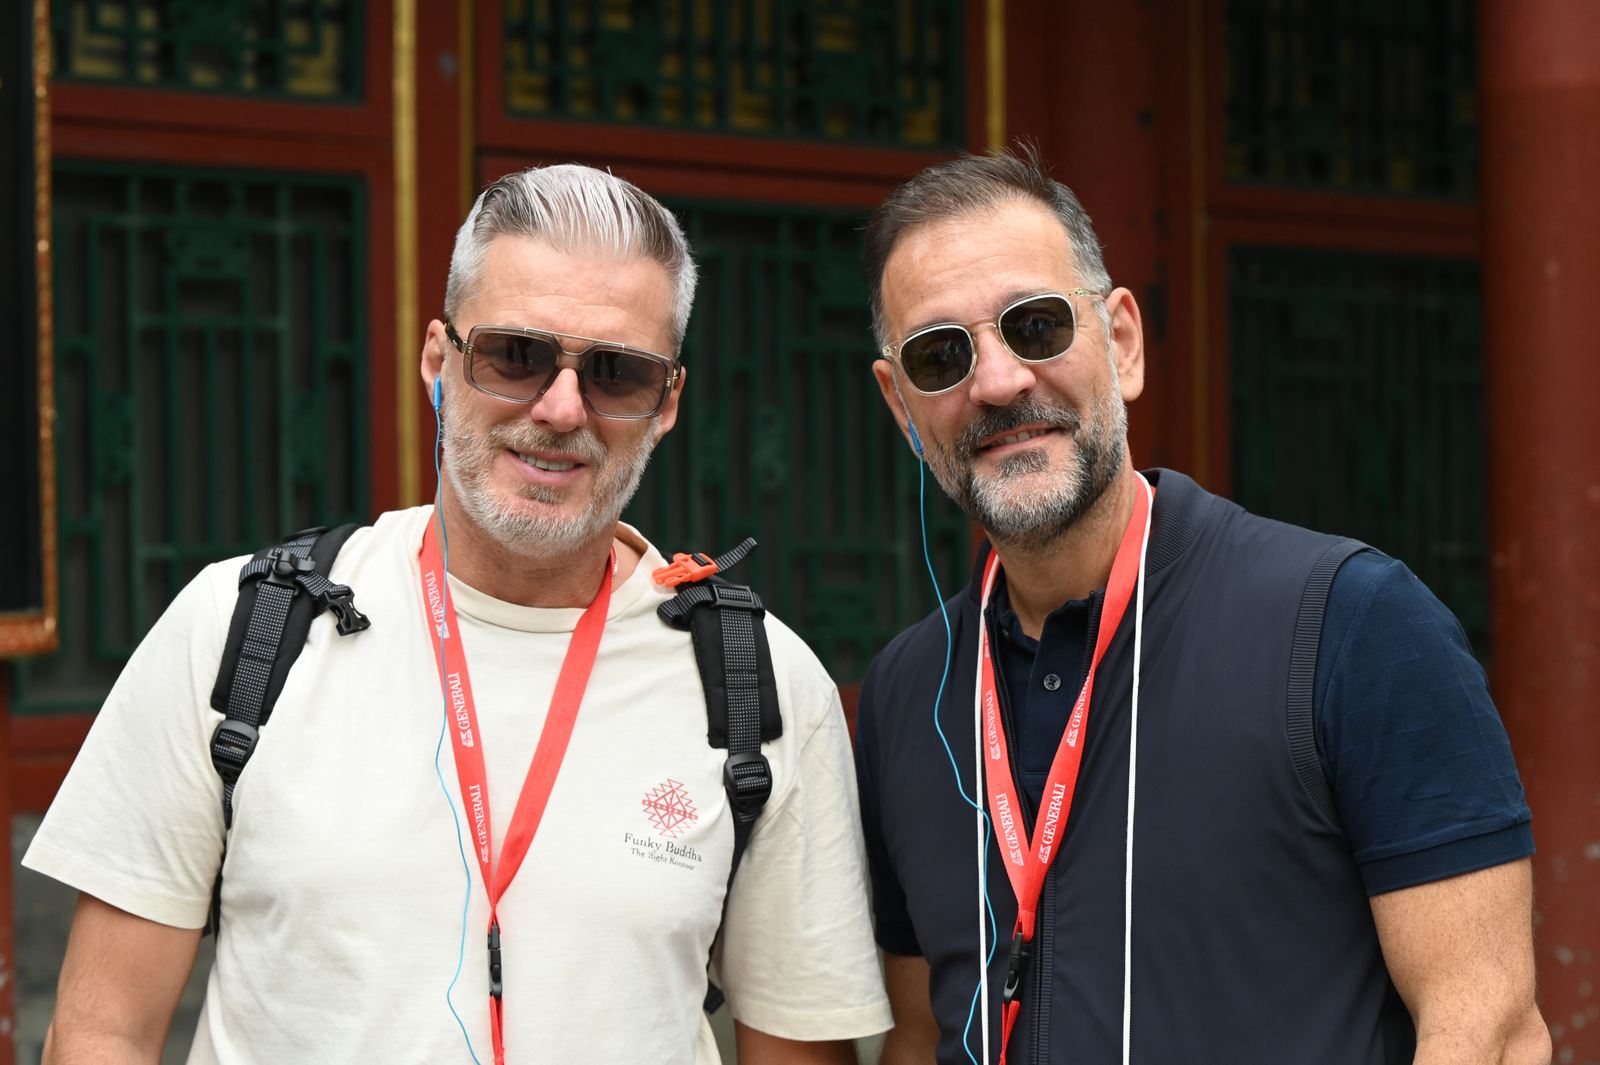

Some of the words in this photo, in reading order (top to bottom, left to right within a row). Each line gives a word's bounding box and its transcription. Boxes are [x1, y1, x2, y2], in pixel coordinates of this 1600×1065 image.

[425, 570, 445, 622] GENERALI
[448, 672, 470, 729] GENERALI
[986, 690, 997, 744] GENERALI
[469, 784, 487, 845] GENERALI
[996, 793, 1019, 849] GENERALI
[1042, 783, 1066, 844] GENERALI
[624, 832, 662, 851] Funky
[665, 841, 702, 862] Buddha
[630, 847, 646, 858] The
